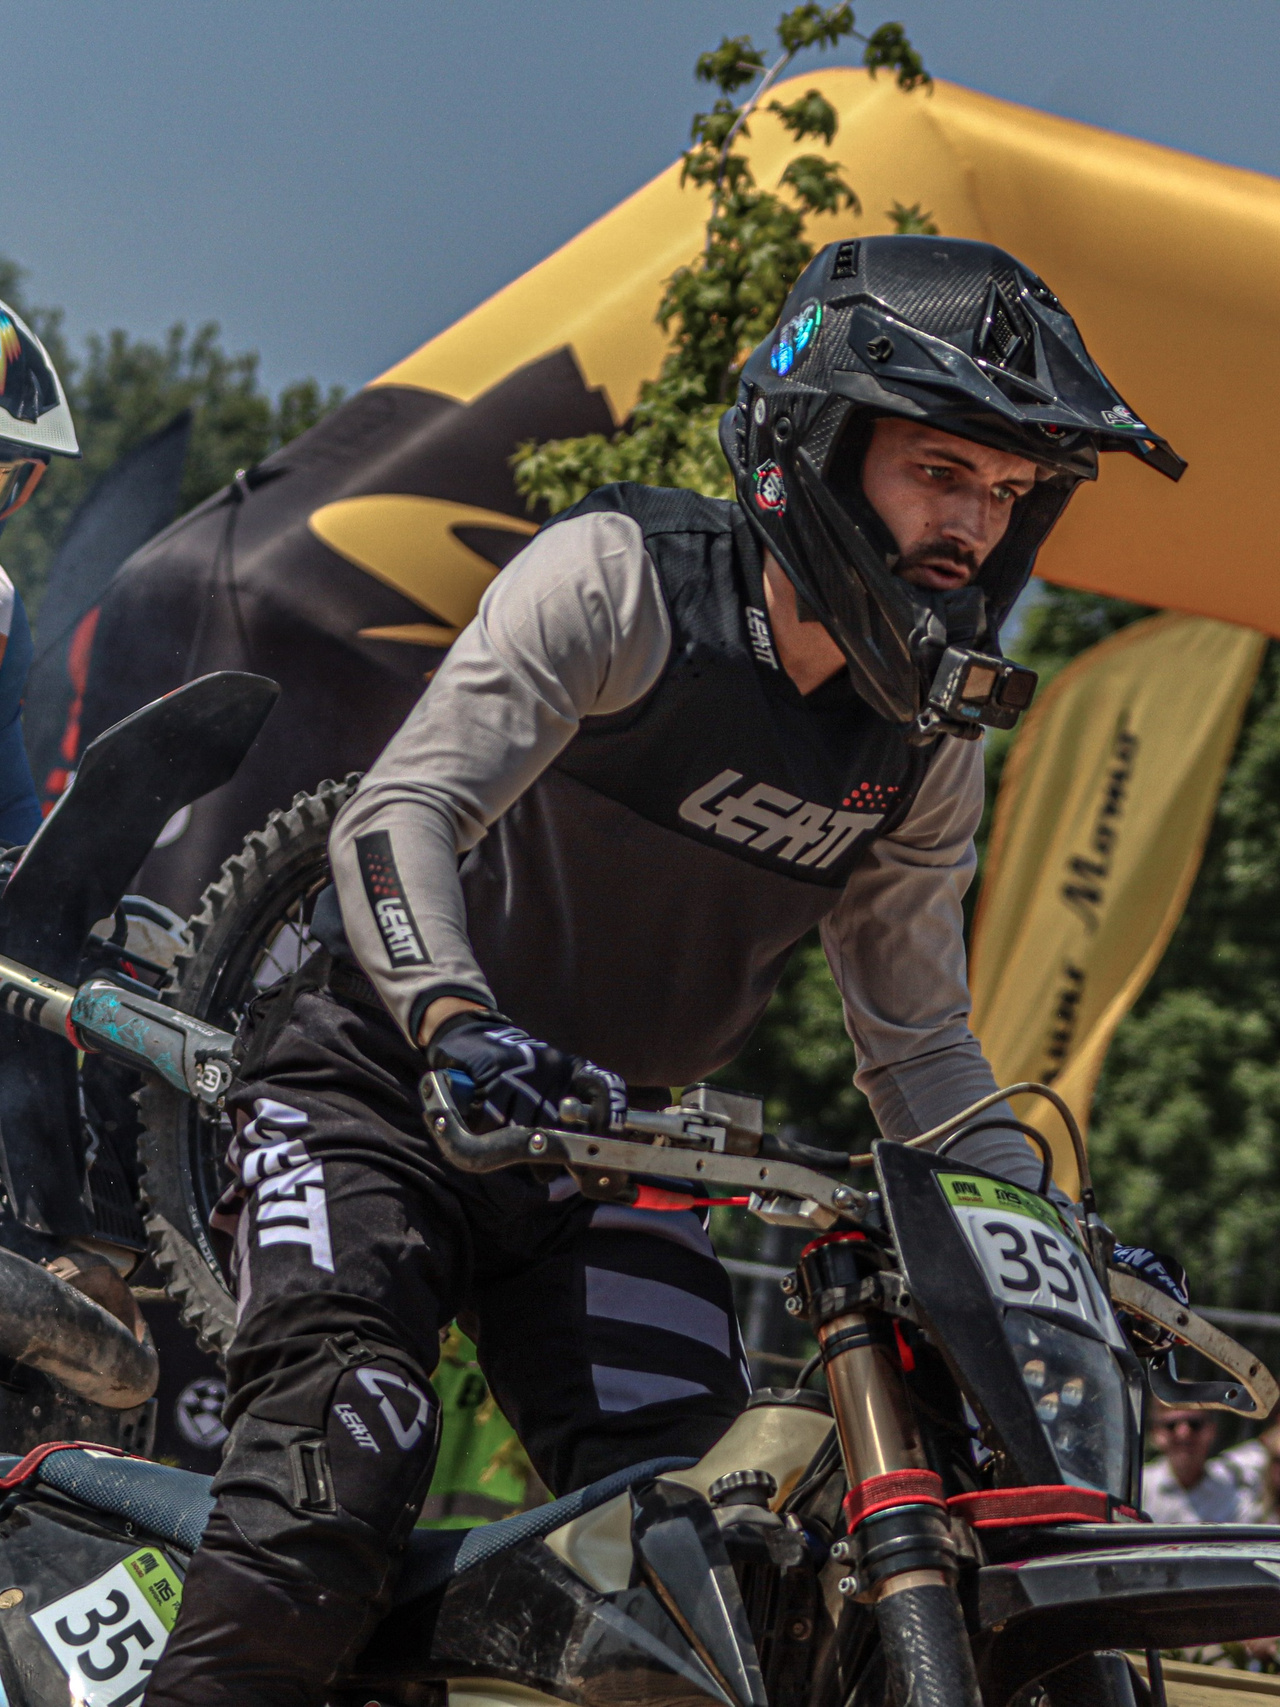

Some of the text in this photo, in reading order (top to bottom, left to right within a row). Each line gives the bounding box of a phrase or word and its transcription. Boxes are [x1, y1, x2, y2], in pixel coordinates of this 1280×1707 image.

[745, 606, 779, 670] LEATT
[678, 768, 885, 869] LEATT
[375, 897, 424, 961] LEATT
[243, 1098, 335, 1273] LEATT
[983, 1221, 1102, 1322] 351
[332, 1403, 380, 1454] LEATT
